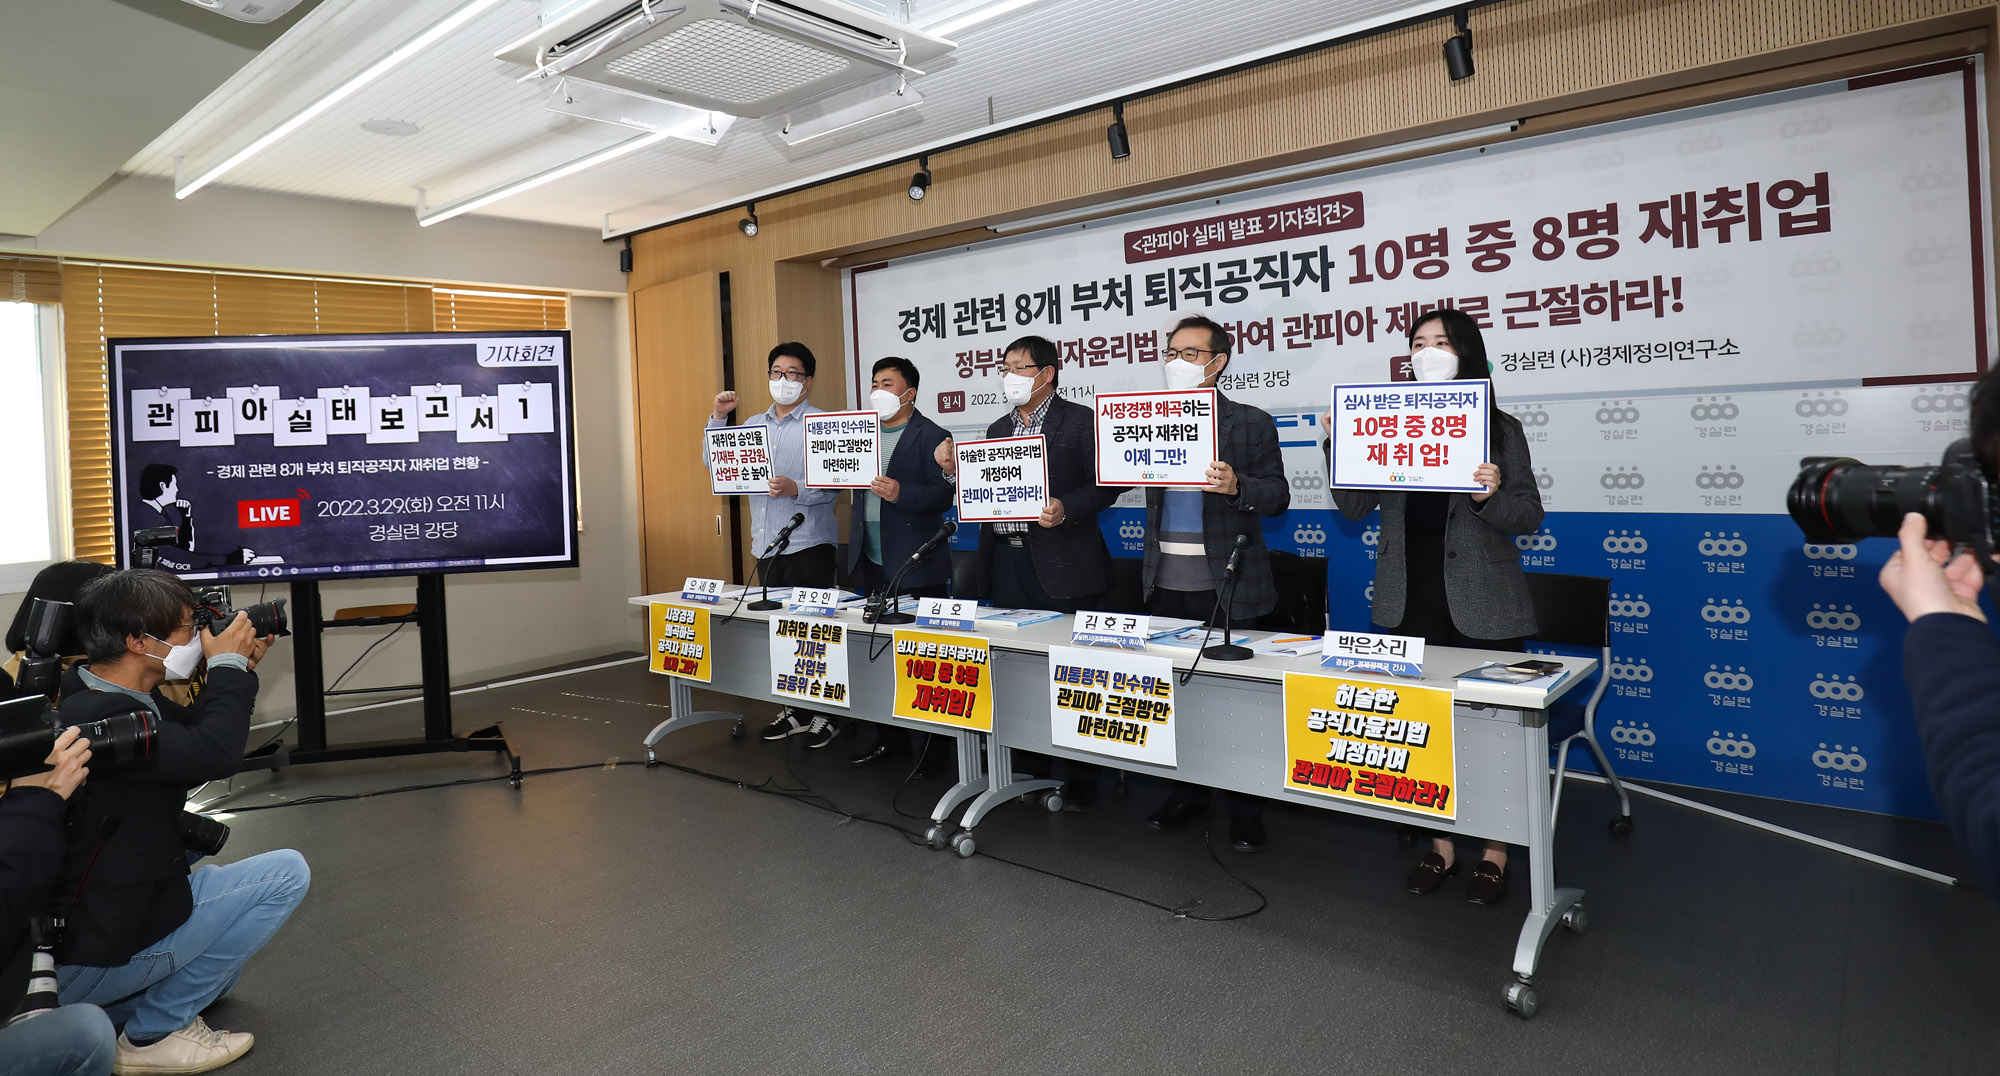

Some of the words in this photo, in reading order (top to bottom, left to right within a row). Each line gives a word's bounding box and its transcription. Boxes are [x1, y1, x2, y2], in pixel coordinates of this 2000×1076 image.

[1132, 228, 1189, 255] <관피아
[1193, 224, 1226, 245] 실태
[1229, 218, 1264, 242] 발표
[1268, 203, 1355, 234] 기자회견>
[899, 302, 946, 343] 경제
[954, 294, 1006, 337] 관련
[1014, 286, 1061, 326] 8개
[1072, 272, 1134, 319] 부처
[1146, 245, 1335, 312] 퇴직공직자
[1348, 226, 1450, 285] 10명
[1465, 219, 1517, 274] 중
[1532, 202, 1620, 262] 8명
[1638, 172, 1831, 251] 재취업
[1282, 306, 1378, 350] 관피아
[1501, 276, 1683, 333] 근절하라!
[485, 344, 554, 363] 기자회견
[1501, 349, 1556, 373] 경실련
[1560, 338, 1741, 372] (사)경제정의연구소
[942, 395, 961, 408] 일시
[1071, 384, 1095, 399] 11시
[1220, 372, 1260, 391] 경실련
[1263, 370, 1291, 388] 강당
[1101, 402, 1152, 419] 시장경쟁
[1155, 400, 1210, 417] 왜곡하는
[1344, 394, 1372, 408] 심사
[1374, 394, 1402, 408] 받은
[1404, 392, 1478, 409] 퇴직공직자
[808, 422, 839, 435] 대통령직
[842, 420, 875, 434] 인수위는
[1112, 425, 1153, 442] 공직자
[1156, 423, 1198, 442] 재취업
[1353, 416, 1398, 437] 10명
[1404, 416, 1426, 437] 중
[1431, 416, 1467, 437] 8명
[1600, 428, 1638, 441] 경실련
[1695, 424, 1736, 439] 경실련
[1800, 421, 1847, 437] 경실련
[711, 434, 736, 448] 재취업
[738, 430, 763, 445] 승인율
[811, 441, 835, 453] 관피아
[838, 439, 872, 452] 근절방안
[711, 450, 738, 464] 기재부,
[740, 448, 769, 463] 금감원,
[960, 450, 986, 463] 허술한
[987, 445, 1041, 461] 공직자윤리법
[1124, 448, 1151, 466] 이제
[1154, 448, 1187, 465] 그만!
[217, 464, 244, 479] 경제
[249, 463, 276, 478] 관련
[280, 461, 303, 477] 8개
[306, 460, 334, 476] 부처
[338, 458, 406, 476] 퇴직공직자
[409, 457, 449, 473] 재취업
[453, 456, 480, 472] 현황
[715, 466, 739, 481] 산업부
[741, 468, 750, 480] 순
[752, 465, 769, 481] 높아
[823, 459, 859, 473] 마련하라!
[981, 466, 1021, 482] 개정하여
[437, 494, 470, 512] 오전
[474, 493, 505, 510] 11시
[962, 488, 994, 504] 관피아
[996, 486, 1042, 502] 근절하라!
[1294, 494, 1322, 504] 경실련
[1603, 493, 1642, 506] 경실련
[1699, 492, 1742, 506] 경실련
[249, 506, 290, 522] LIVE
[369, 523, 419, 542] 경실련
[425, 522, 458, 539] 강당
[1296, 548, 1325, 558] 경실련
[1607, 557, 1646, 570] 경실련
[1702, 560, 1745, 574] 경실련
[1808, 564, 1855, 579] 경실련
[665, 608, 696, 625] 시장경쟁
[665, 624, 695, 641] 왜곡하는
[776, 619, 808, 639] 재취업
[810, 624, 844, 643] 승인율
[1610, 620, 1649, 634] 경실련
[1705, 627, 1748, 642] 경실련
[658, 639, 680, 655] 공직자
[680, 642, 704, 660] 재취업
[794, 640, 827, 659] 기재부
[1339, 636, 1407, 658] 박은소리
[1811, 633, 1858, 649] 경실련
[896, 639, 916, 656] 심사
[917, 641, 937, 658] 받은
[938, 643, 987, 664] 퇴직공직자
[794, 659, 827, 678] 산업부
[906, 658, 935, 680] 10명
[937, 663, 952, 684] 중
[954, 664, 980, 687] 8명
[1392, 664, 1406, 672] 간사
[776, 674, 807, 694] 금융위
[809, 680, 822, 697] 순
[822, 681, 846, 701] 높아
[1054, 664, 1111, 690] 대통령직
[1112, 669, 1172, 698] 인수위는
[1334, 682, 1399, 713] 허술한
[1612, 684, 1652, 698] 경실련
[912, 684, 977, 718] 재취업!
[1055, 688, 1103, 714] 관피아
[1104, 694, 1172, 724] 근절방안
[1708, 693, 1751, 709] 경실련
[1814, 703, 1862, 719] 경실련
[1077, 716, 1148, 746] 마련하라!
[1306, 710, 1430, 749] 공직자윤리법
[1326, 736, 1410, 772] 개정하여
[1614, 747, 1654, 763] 경실련
[1711, 759, 1754, 776] 경실련
[1291, 758, 1352, 792] 관피아
[1354, 768, 1449, 811] 근절하라!
[1817, 773, 1864, 791] 경실련
